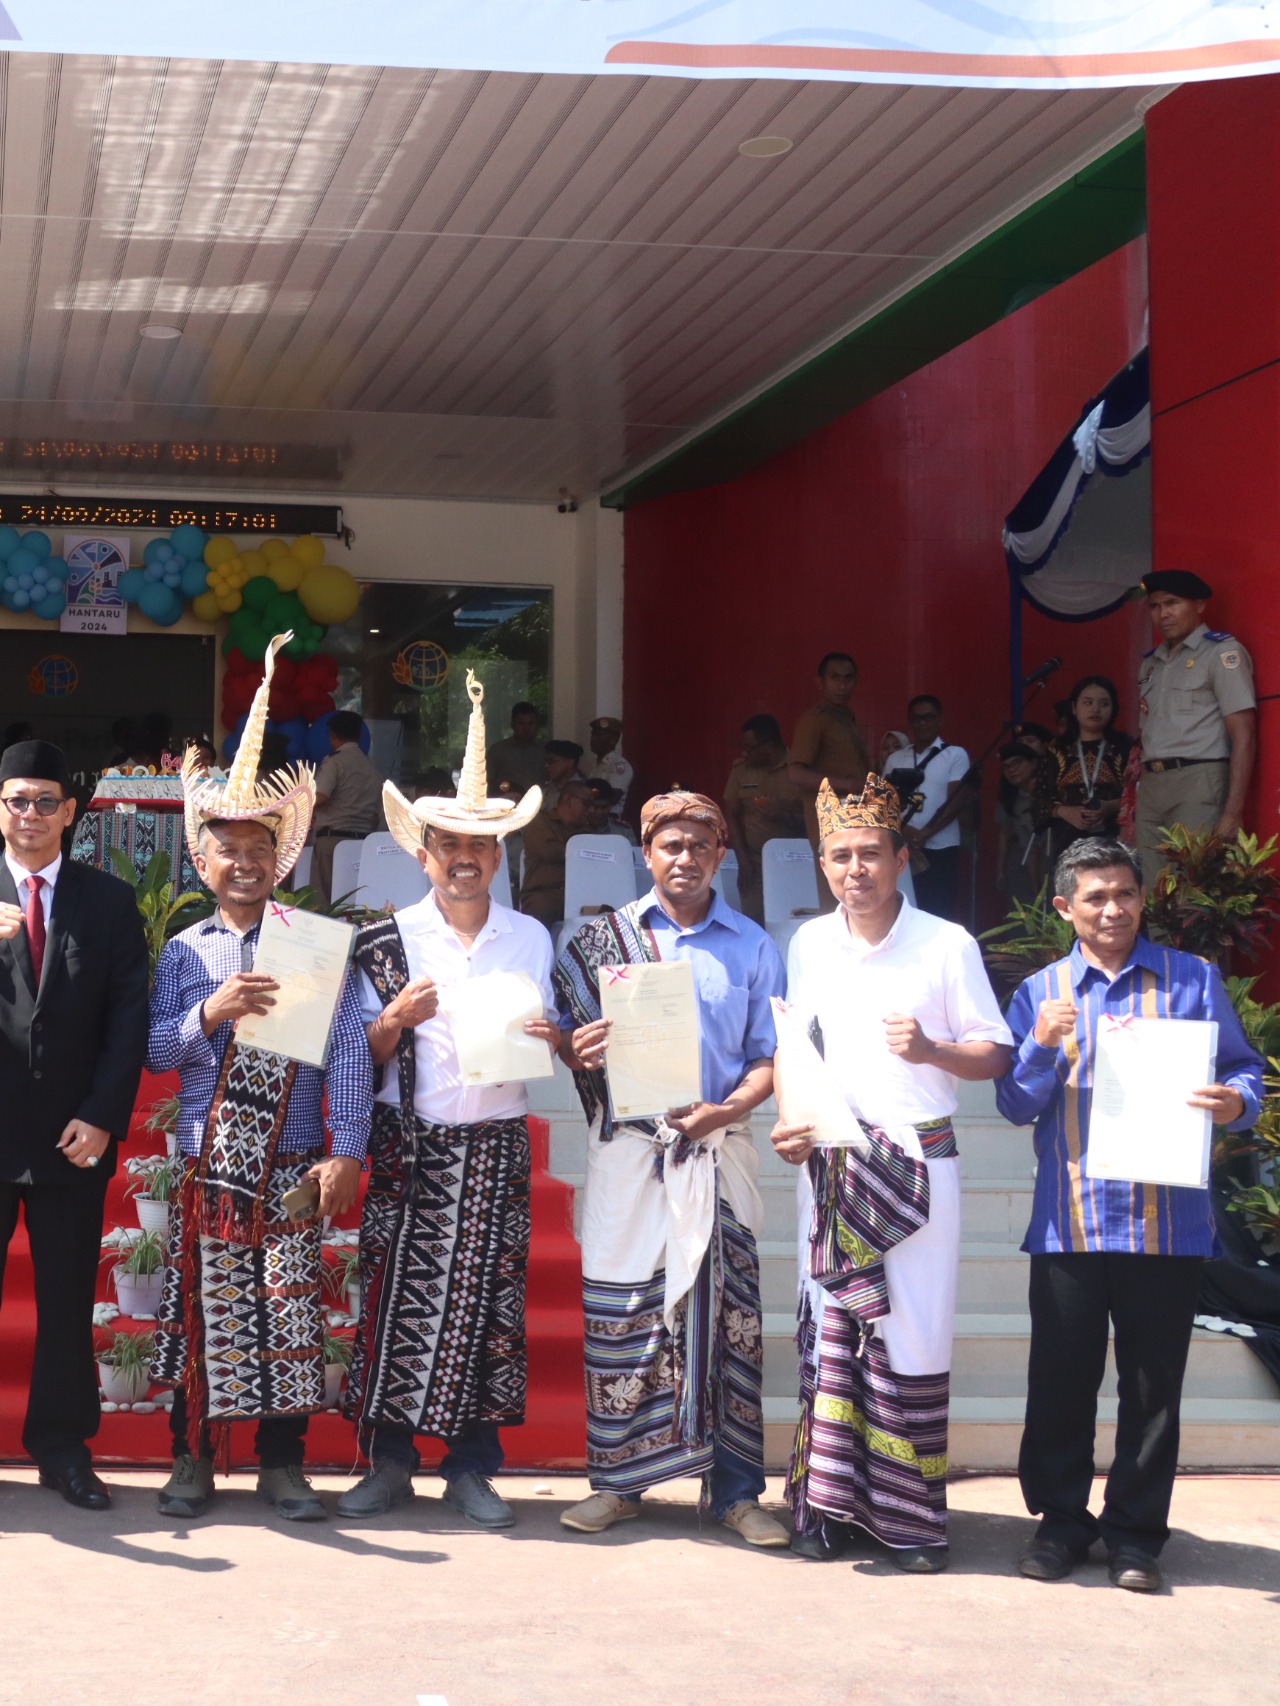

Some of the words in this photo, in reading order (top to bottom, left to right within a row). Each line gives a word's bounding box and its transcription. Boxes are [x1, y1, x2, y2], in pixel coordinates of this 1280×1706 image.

[68, 608, 120, 618] HANTARU
[80, 622, 107, 631] 2024
[161, 752, 182, 773] 64
